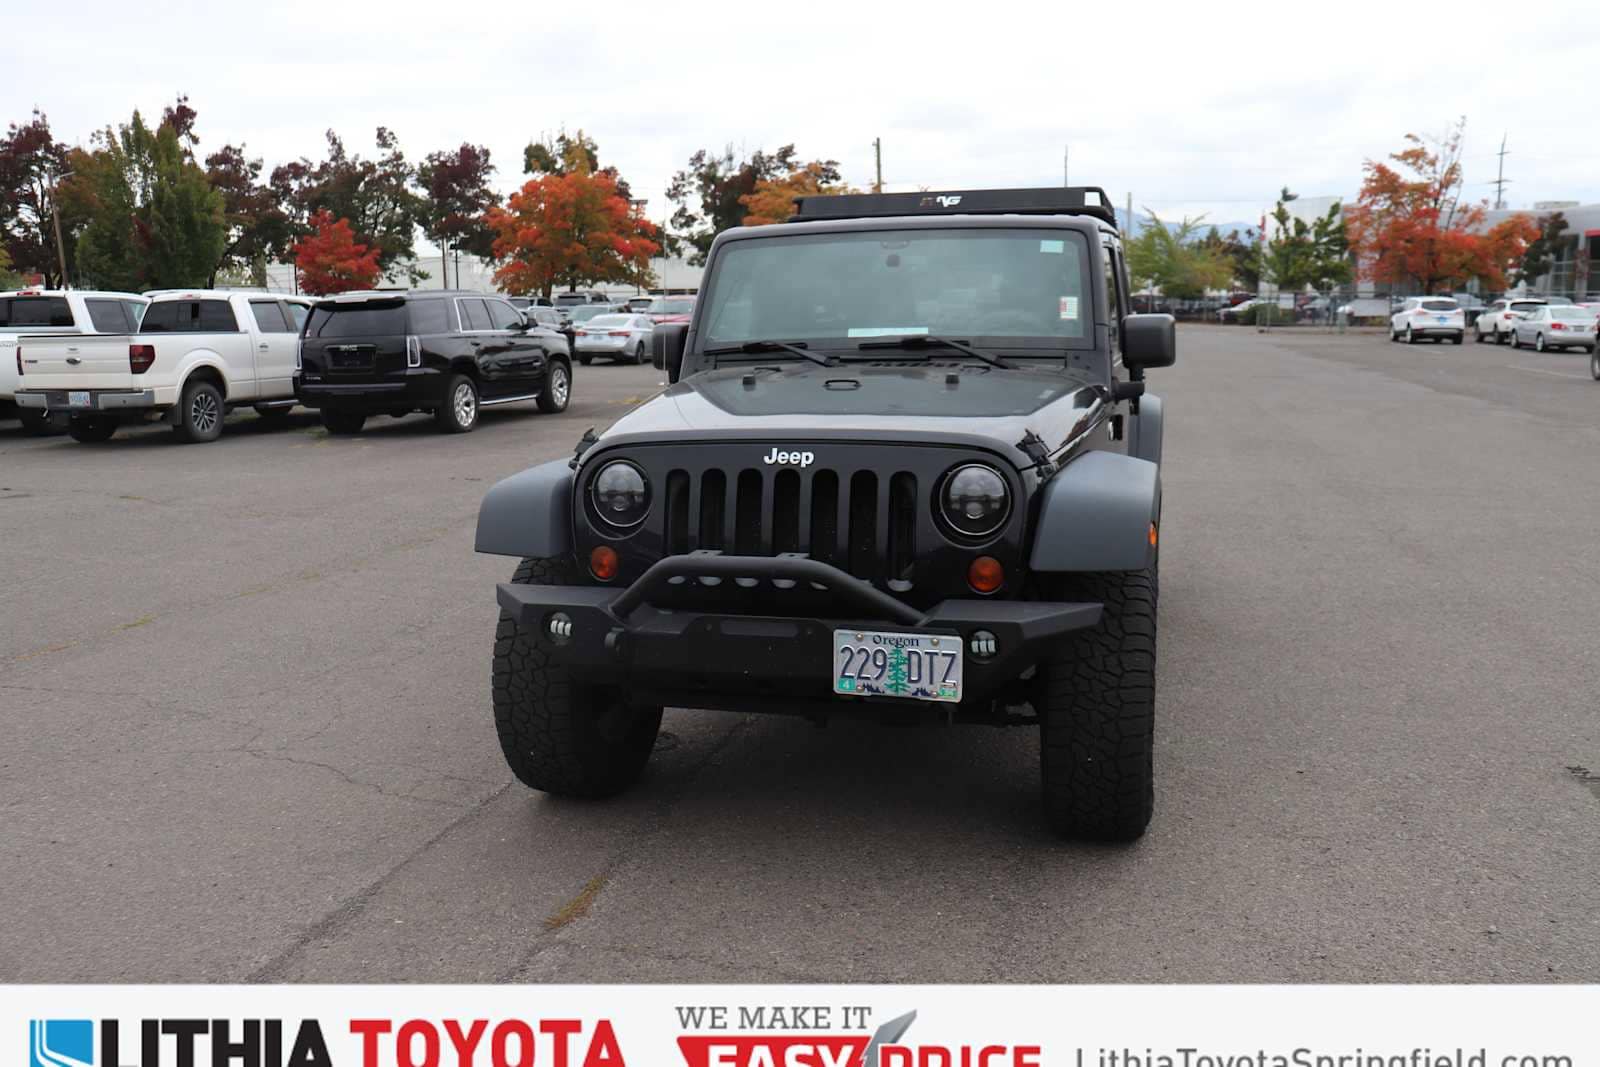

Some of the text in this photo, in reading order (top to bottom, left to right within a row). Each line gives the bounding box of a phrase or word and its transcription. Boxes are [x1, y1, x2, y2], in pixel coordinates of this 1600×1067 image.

[763, 447, 815, 468] Jeep
[872, 634, 920, 649] Oregon
[840, 644, 957, 686] 229 DTZ
